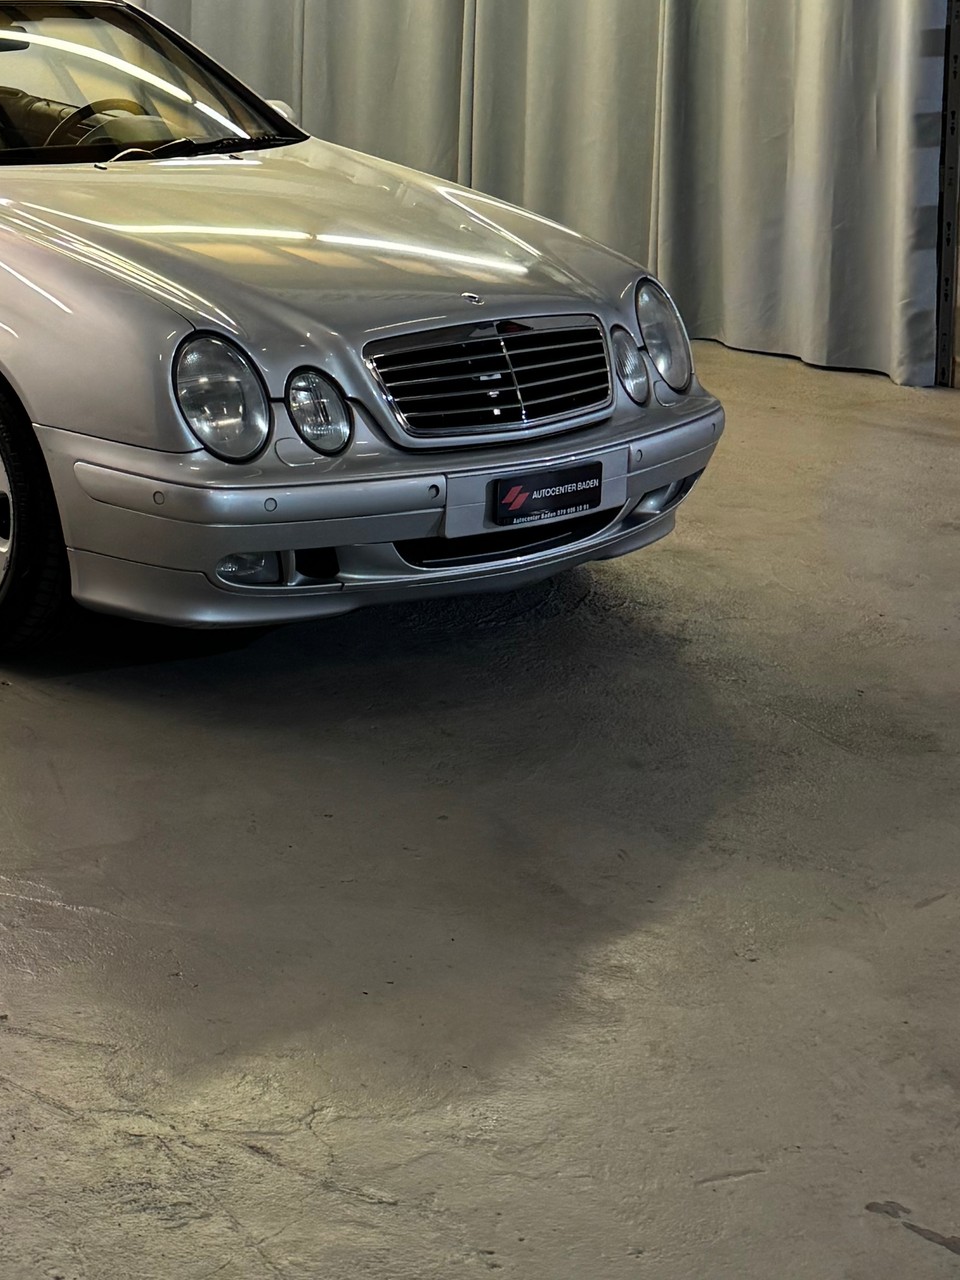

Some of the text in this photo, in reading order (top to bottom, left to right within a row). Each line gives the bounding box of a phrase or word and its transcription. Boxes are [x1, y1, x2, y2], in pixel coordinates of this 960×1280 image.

[532, 479, 599, 499] AUTOCENTER BADEN
[513, 514, 540, 524] Autocenter
[541, 511, 556, 519] Baden
